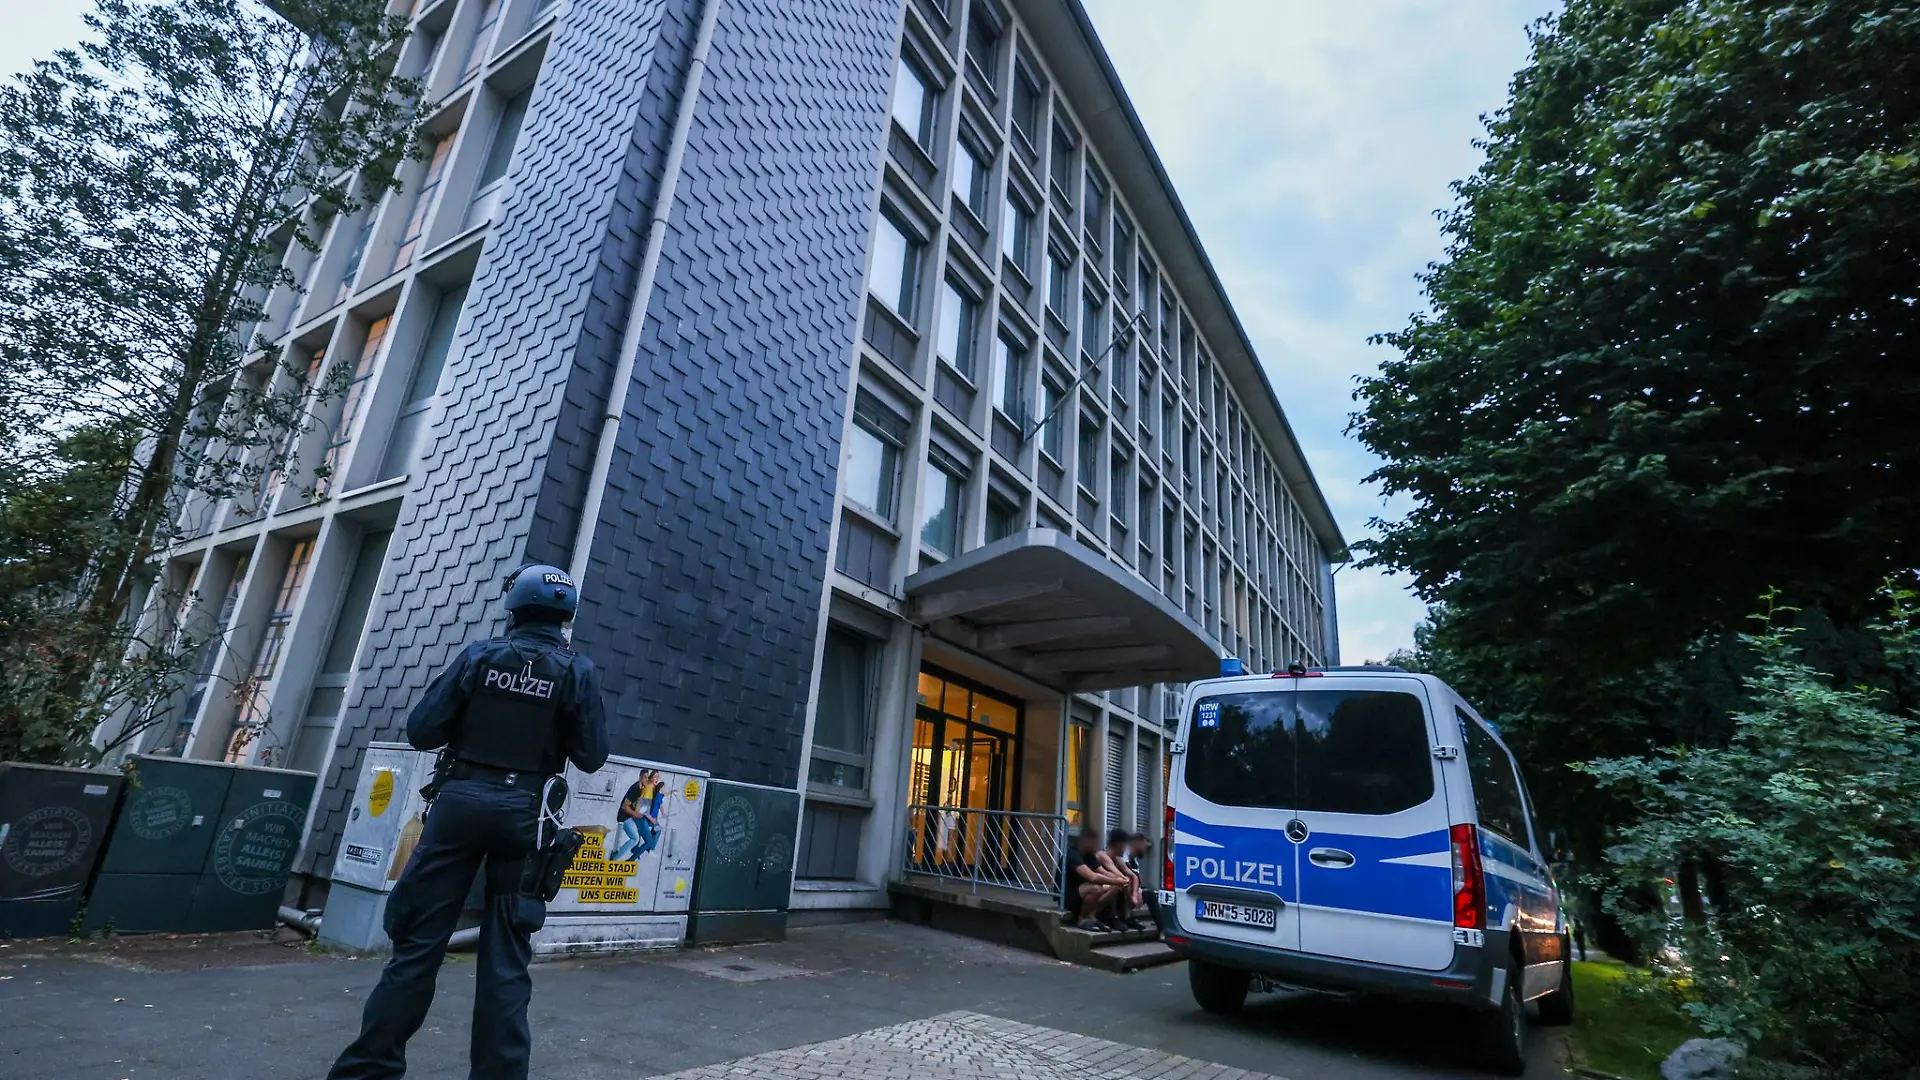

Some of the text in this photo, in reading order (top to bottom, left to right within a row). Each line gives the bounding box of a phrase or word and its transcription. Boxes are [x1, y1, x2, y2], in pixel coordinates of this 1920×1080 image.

[485, 669, 555, 699] POLIZEI
[1200, 703, 1219, 711] NRW
[244, 803, 305, 822] INITIATIV
[264, 823, 286, 835] WIR
[246, 832, 293, 848] MACHEN
[240, 844, 286, 861] ALLE(S)
[581, 849, 603, 860] EINE
[236, 855, 282, 871] SAUBER
[569, 862, 636, 873] AUBERE STADT
[1186, 856, 1283, 887] POLIZEI
[561, 875, 624, 886] RNETZEN WIR
[580, 890, 637, 900] UNS GERNE!
[1203, 902, 1274, 925] NRW 5-5028
